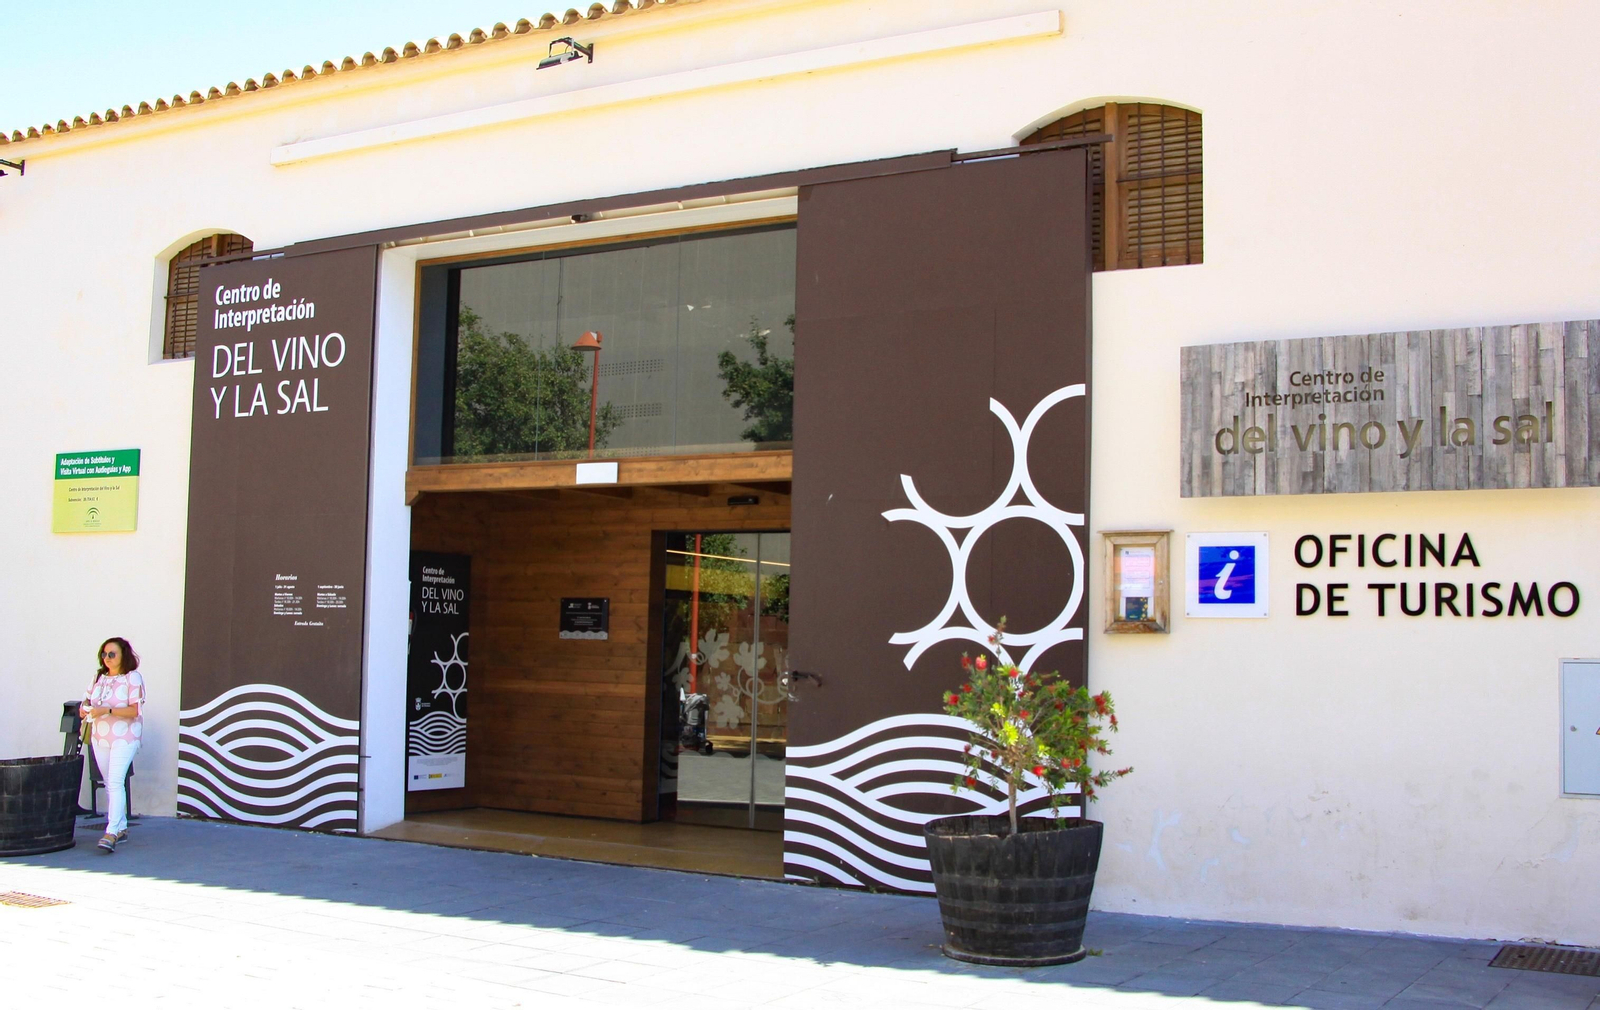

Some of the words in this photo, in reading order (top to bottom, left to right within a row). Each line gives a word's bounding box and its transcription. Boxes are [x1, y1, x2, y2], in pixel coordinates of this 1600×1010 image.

[216, 284, 260, 305] Centro
[263, 278, 281, 299] de
[214, 298, 315, 332] Interpretación
[213, 342, 262, 378] DEL
[272, 332, 346, 372] VINO
[1289, 371, 1354, 387] Centro
[1360, 366, 1385, 383] de
[210, 386, 227, 419] Y
[234, 382, 269, 417] LA
[277, 378, 329, 415] SAL
[1245, 384, 1385, 409] Interpretación
[1215, 413, 1275, 456] del
[1291, 413, 1386, 450] vino
[1397, 419, 1424, 459] y
[1440, 405, 1475, 447] la
[1492, 401, 1553, 445] sal
[60, 467, 72, 475] Visita
[72, 466, 86, 475] Virtual
[1294, 532, 1480, 568] OFICINA
[422, 566, 438, 575] Centro
[439, 567, 445, 575] de
[422, 574, 455, 584] Interpretación
[422, 586, 439, 599] DEL
[441, 588, 464, 601] VINO
[1295, 583, 1349, 617] DE
[1367, 581, 1580, 617] TURISMO
[421, 601, 428, 612] Y
[429, 601, 441, 613] LA
[443, 602, 459, 614] SAL
